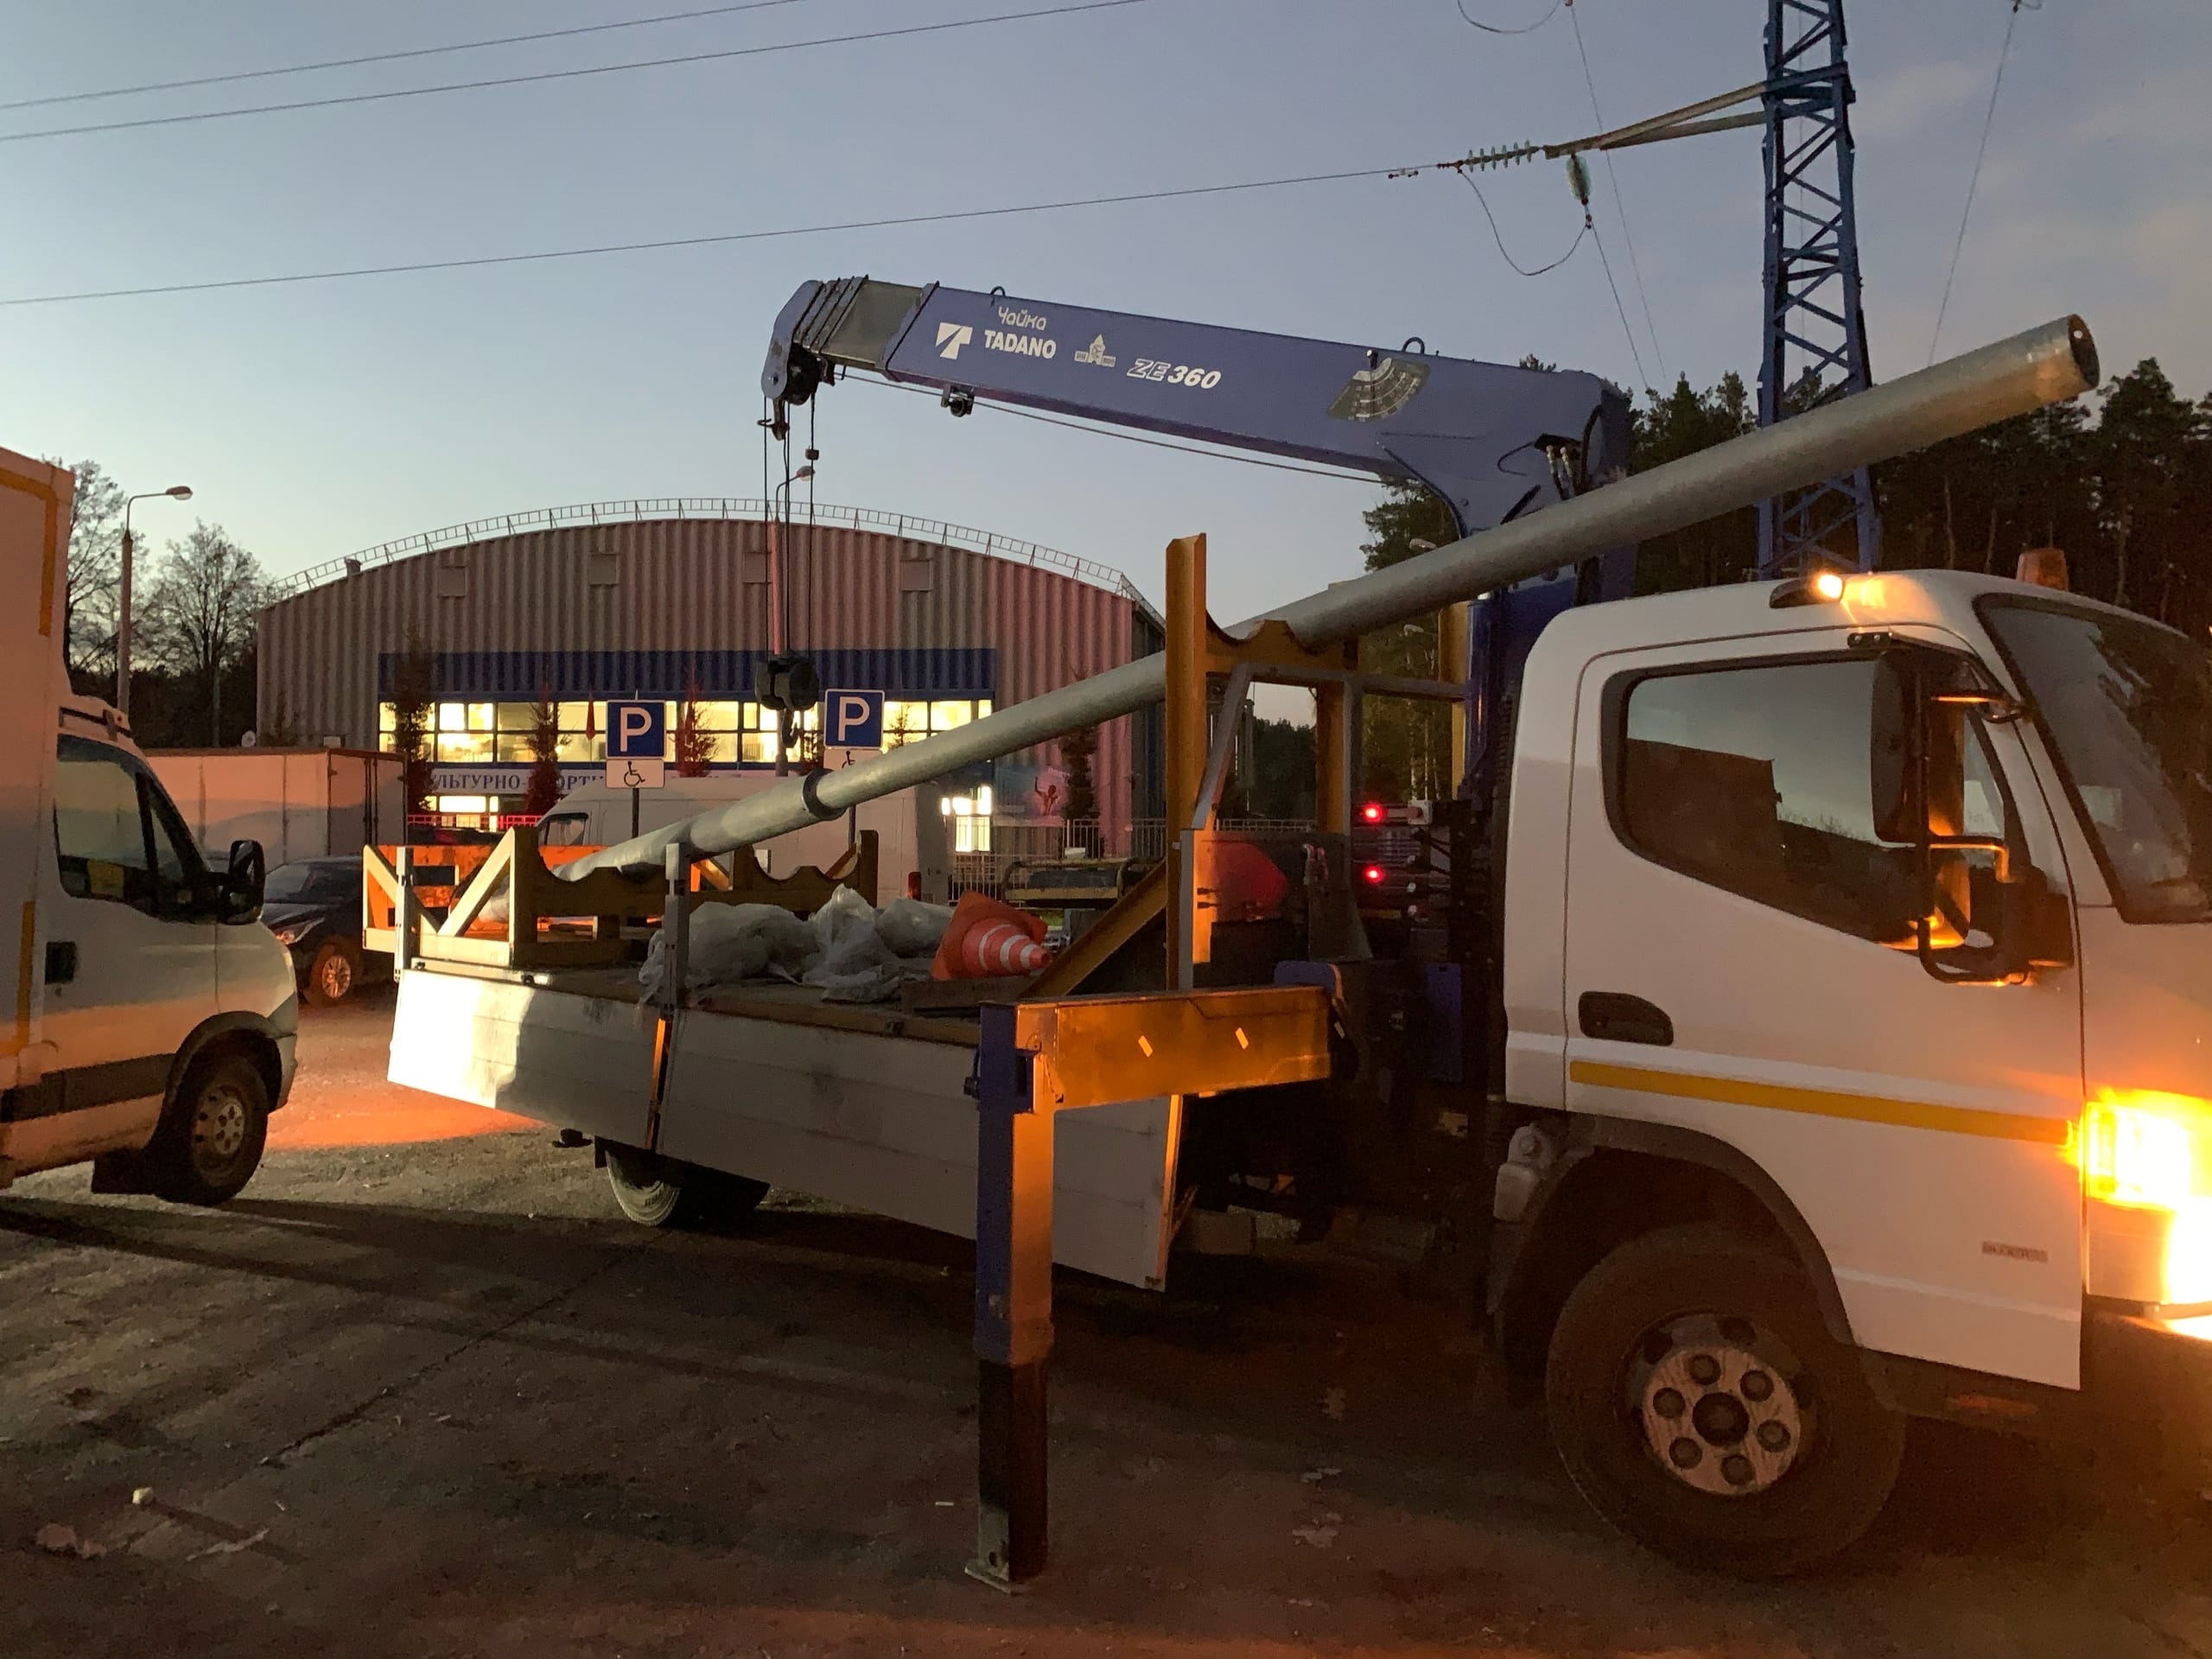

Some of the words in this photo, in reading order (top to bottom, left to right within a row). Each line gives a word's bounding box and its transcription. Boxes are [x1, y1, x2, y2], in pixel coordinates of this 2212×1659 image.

[997, 306, 1047, 331] Чайка
[984, 329, 1057, 359] TADANO
[620, 707, 652, 752] P
[838, 696, 870, 741] P
